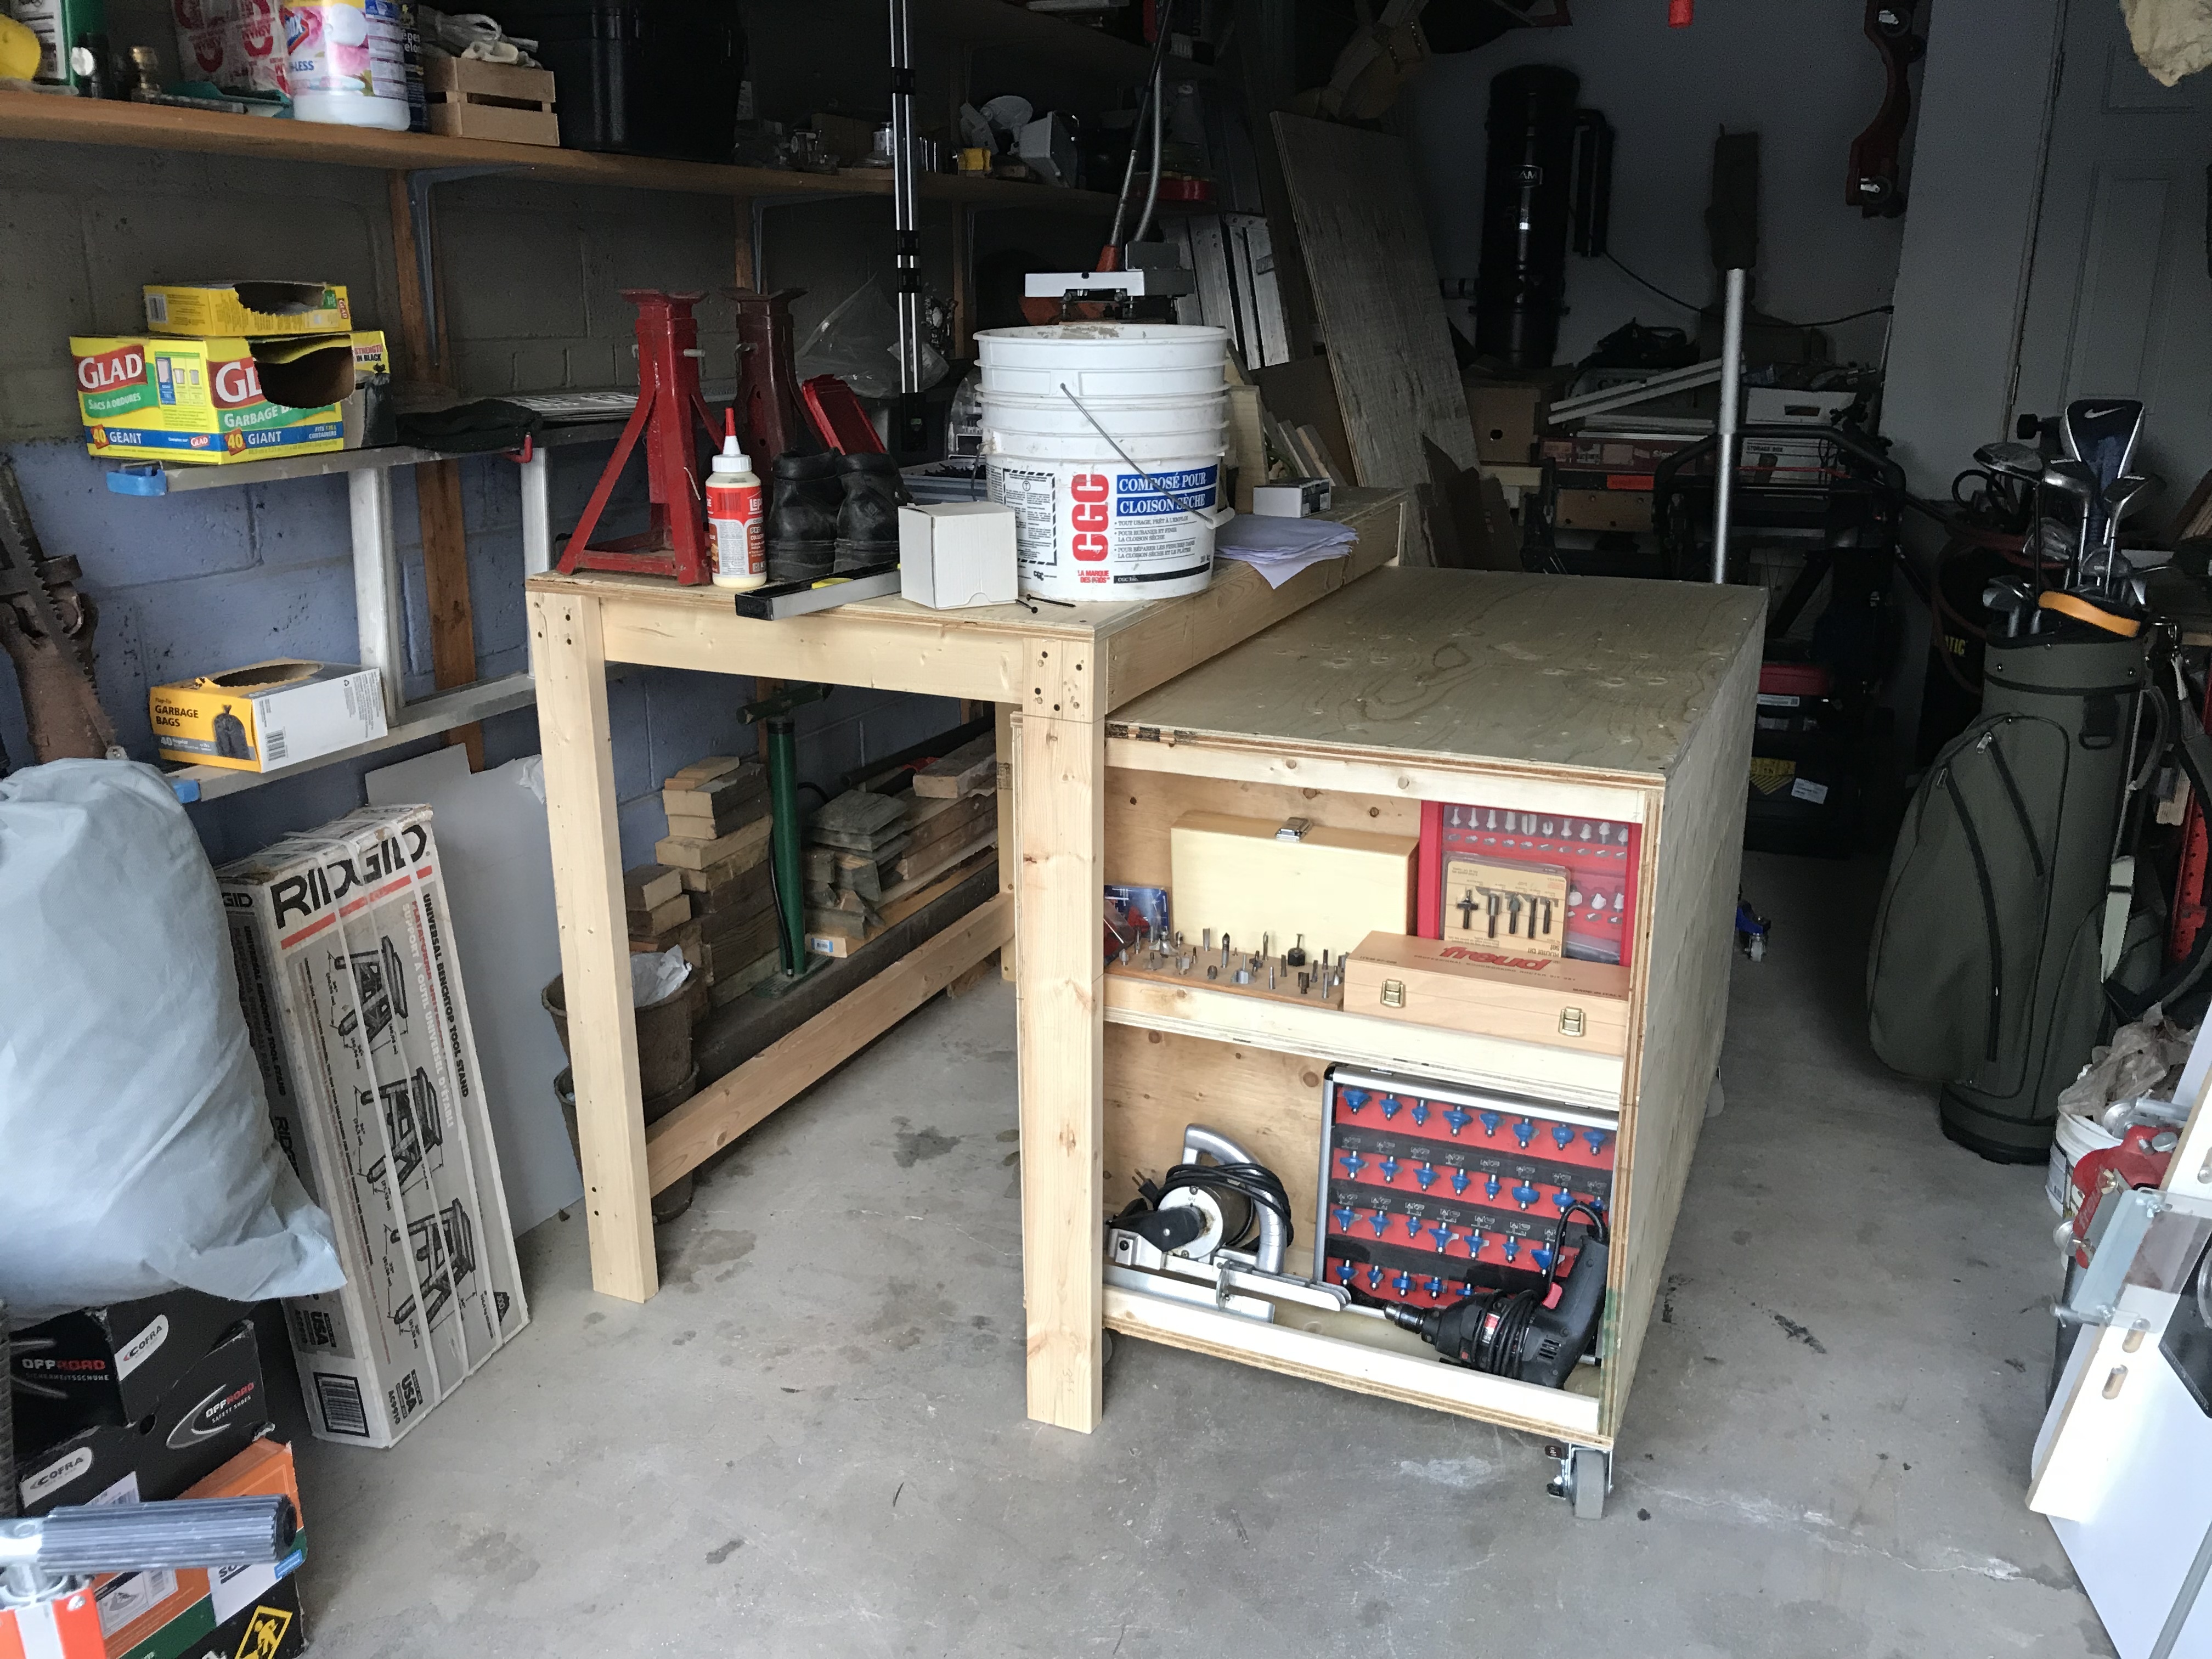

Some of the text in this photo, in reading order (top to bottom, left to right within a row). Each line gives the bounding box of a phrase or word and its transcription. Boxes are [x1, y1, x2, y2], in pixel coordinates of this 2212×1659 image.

[78, 353, 142, 388] GLAD
[364, 354, 381, 362] BLACK
[216, 362, 263, 403] GL
[224, 404, 278, 428] GARBAGE
[93, 428, 142, 444] 40 GÉANT
[190, 437, 208, 447] GLAD
[228, 433, 244, 449] 40
[248, 431, 281, 445] GIANT
[1119, 472, 1207, 492] COMPOSÉ POUR
[1120, 493, 1206, 514] CLOISON SÈCHE
[1071, 473, 1109, 562] CGC
[155, 704, 199, 719] GARBAGE
[156, 715, 181, 727] BAGS
[161, 737, 173, 747] 40
[270, 824, 427, 929] RIDGID
[222, 892, 252, 908] GID
[1439, 946, 1552, 971] freud
[423, 893, 469, 1097] UNIVERSAL BENCHTOP TOOL STAND
[403, 903, 420, 958] SUPPORT
[417, 974, 430, 1009] OUTIL
[425, 1011, 443, 1075] UNIVERSEL
[438, 1076, 454, 1128] D'ÉTABLI
[311, 1311, 329, 1345] USA
[129, 1325, 163, 1358] COFRA
[402, 1373, 417, 1415] USA
[212, 1395, 251, 1424] SAFETY SHOES
[38, 1456, 84, 1485] COFRA
